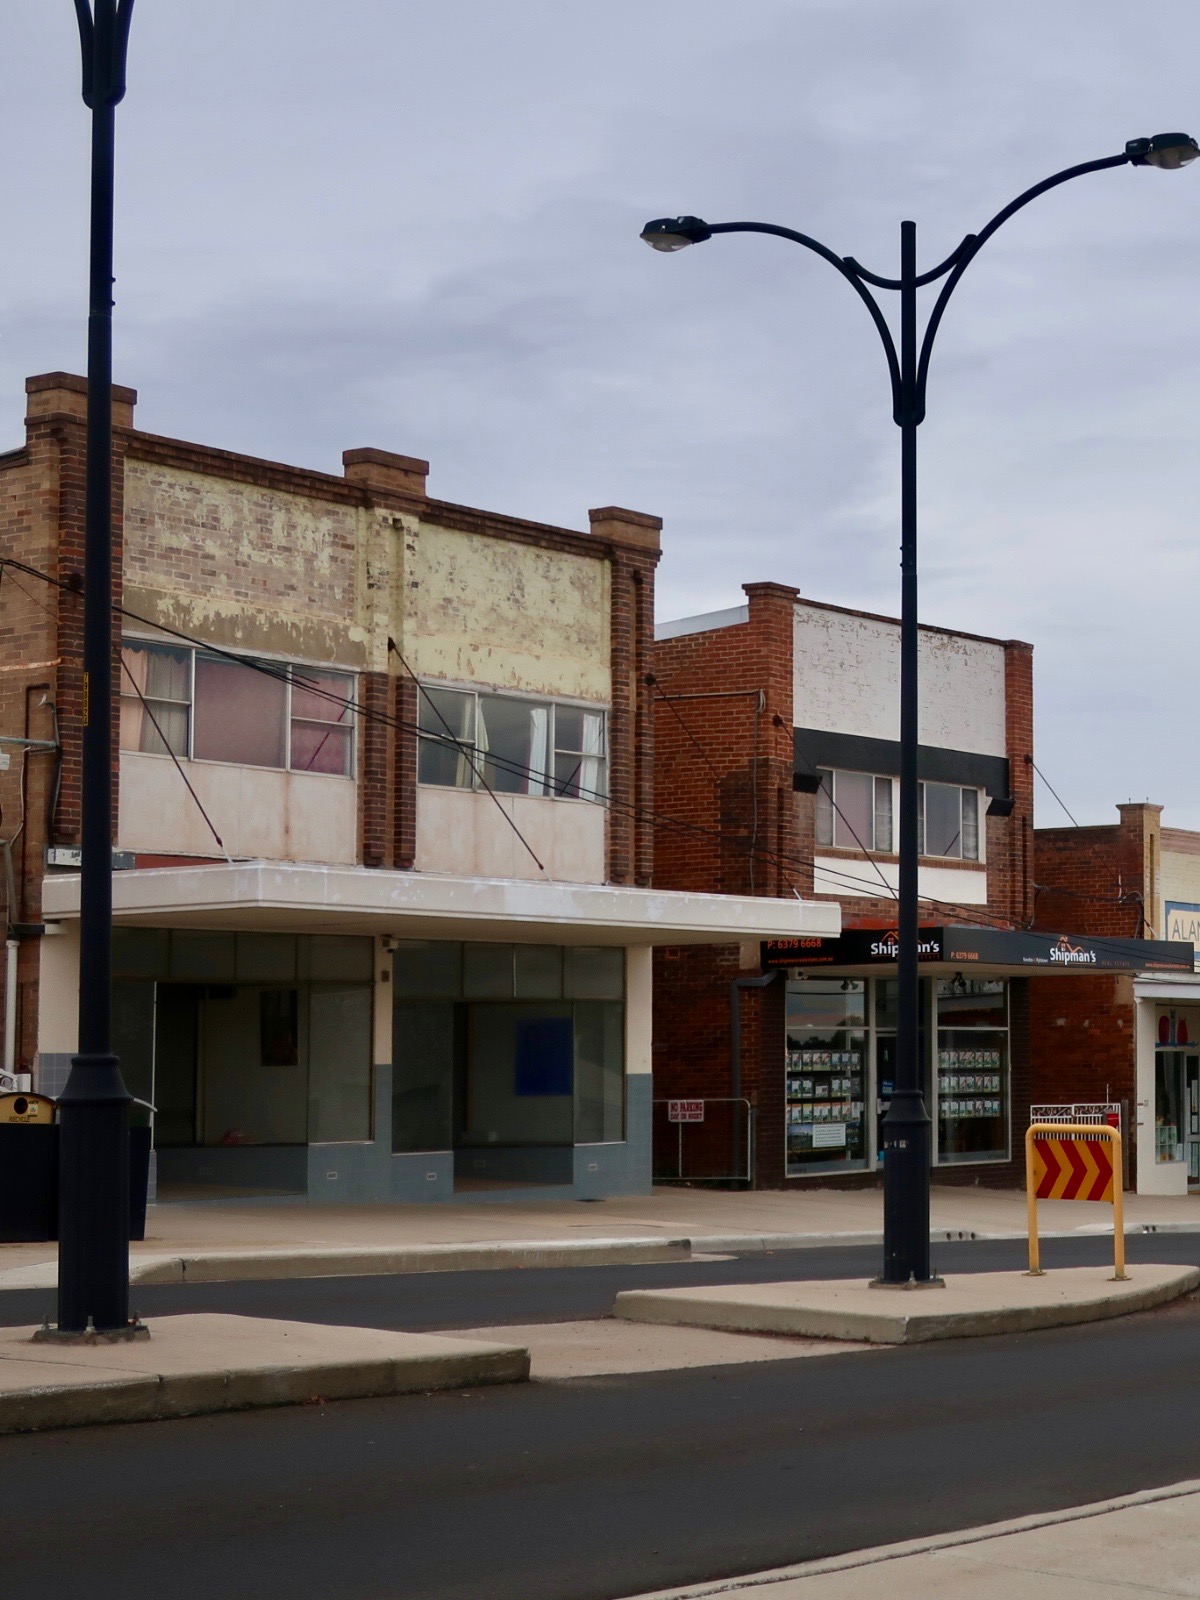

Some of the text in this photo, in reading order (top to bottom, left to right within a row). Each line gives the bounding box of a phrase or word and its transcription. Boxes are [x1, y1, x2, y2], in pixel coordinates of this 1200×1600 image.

[778, 939, 799, 949] 6379
[800, 938, 822, 948] 6668
[1049, 947, 1097, 966] Shipman's
